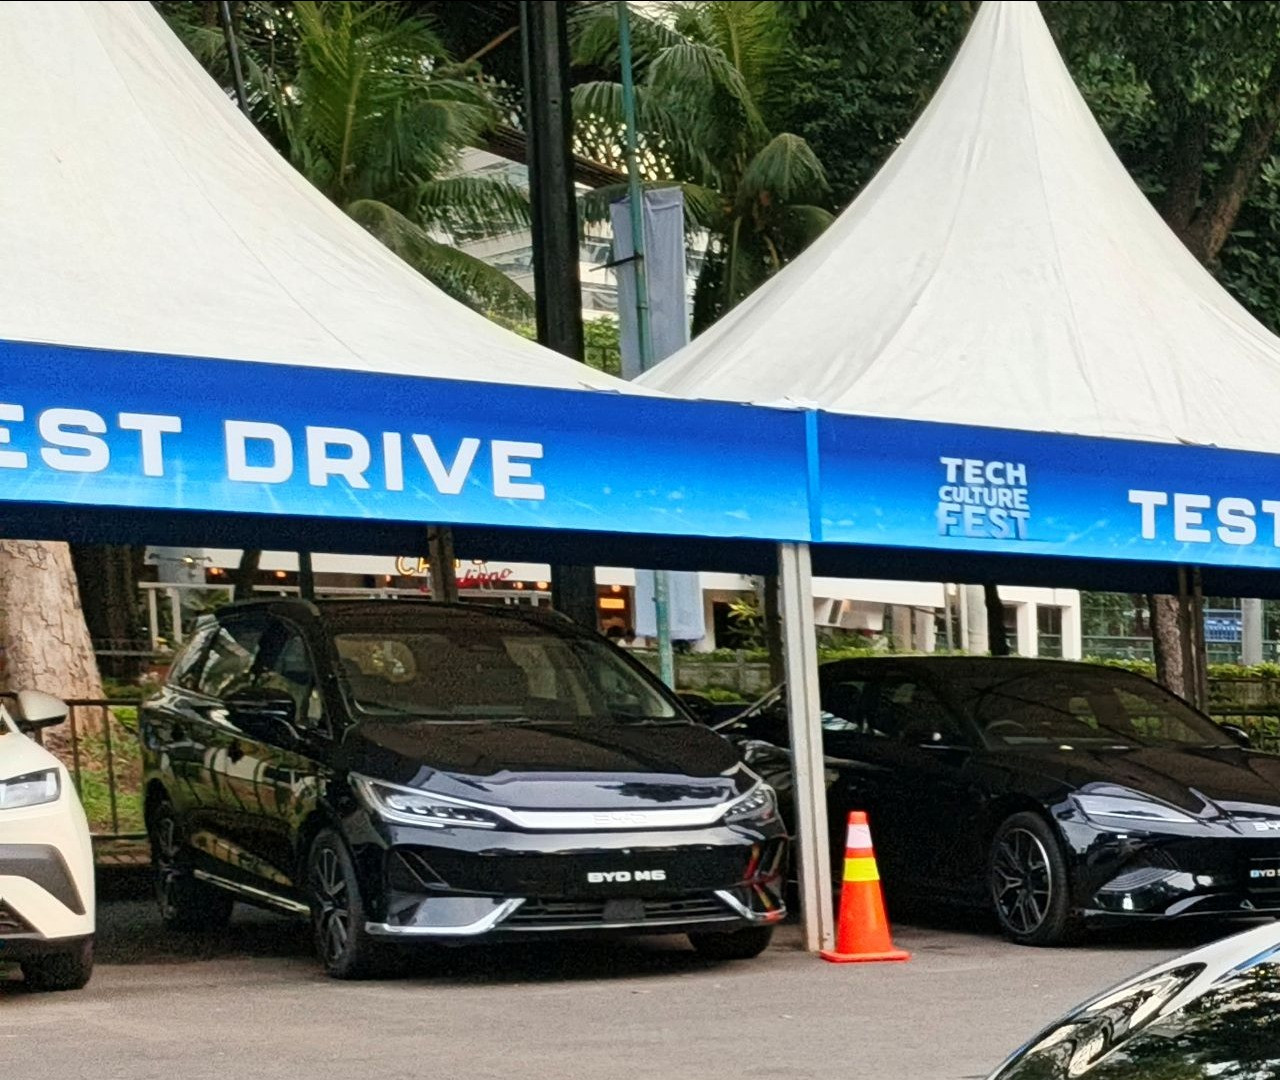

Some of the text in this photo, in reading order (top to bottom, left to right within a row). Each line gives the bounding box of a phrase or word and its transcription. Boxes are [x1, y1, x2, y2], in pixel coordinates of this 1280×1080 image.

[224, 419, 546, 500] DRIVE
[939, 456, 1028, 486] TECH
[938, 485, 1029, 510] CULTURE
[937, 501, 1031, 541] FEST
[587, 869, 667, 883] BYD M6
[1250, 868, 1276, 878] BYD
